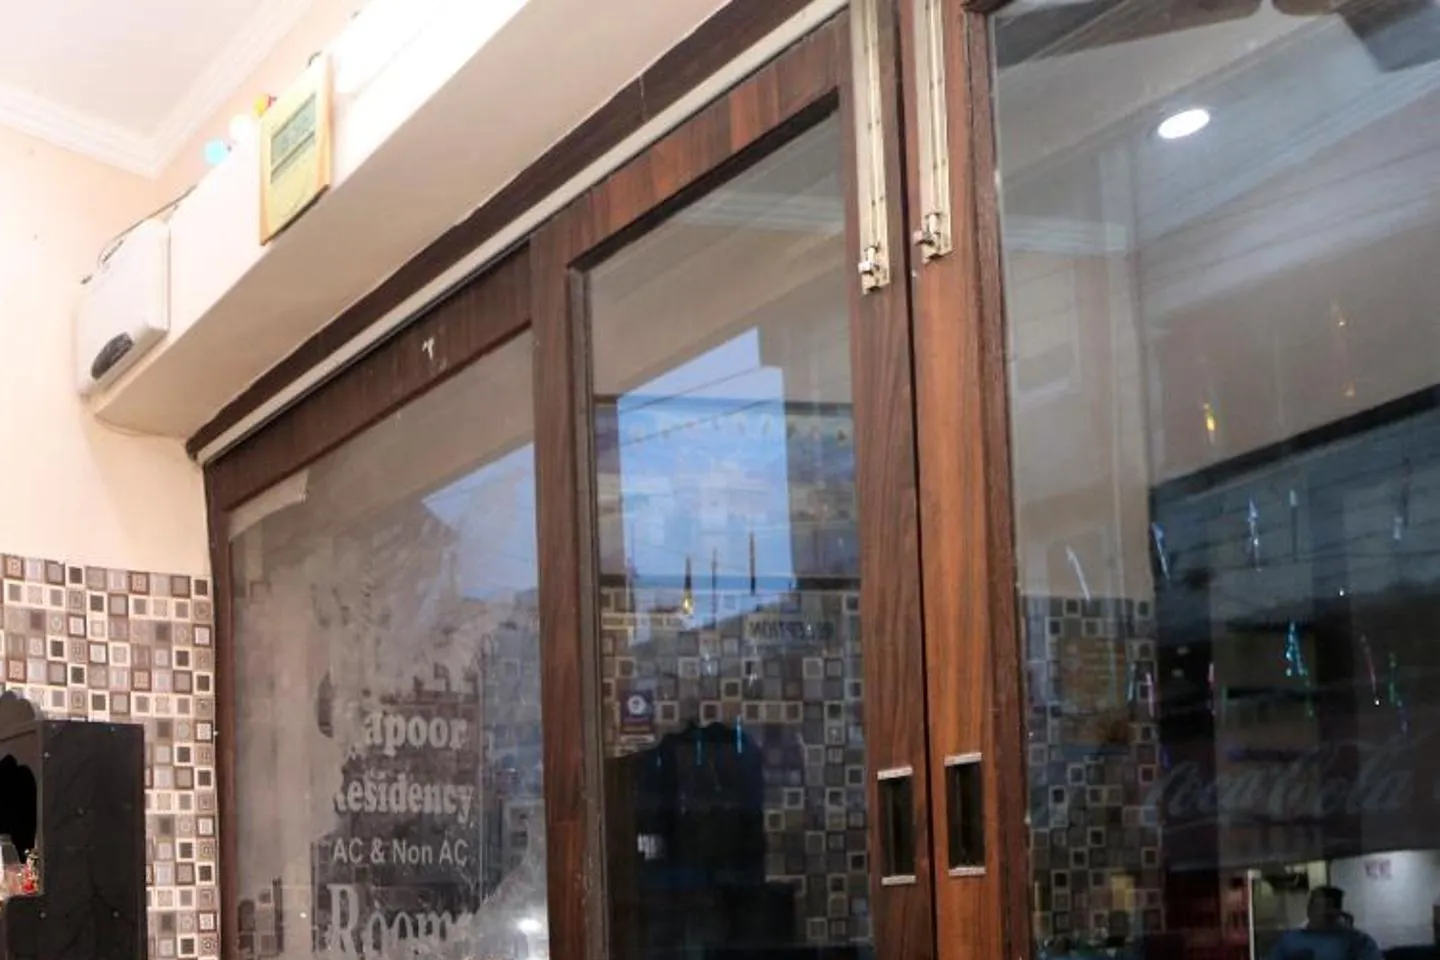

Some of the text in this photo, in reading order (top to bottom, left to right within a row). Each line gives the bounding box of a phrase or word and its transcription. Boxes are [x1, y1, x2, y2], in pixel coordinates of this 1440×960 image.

[357, 711, 468, 756] apoor
[333, 837, 469, 867] AC & Non AC
